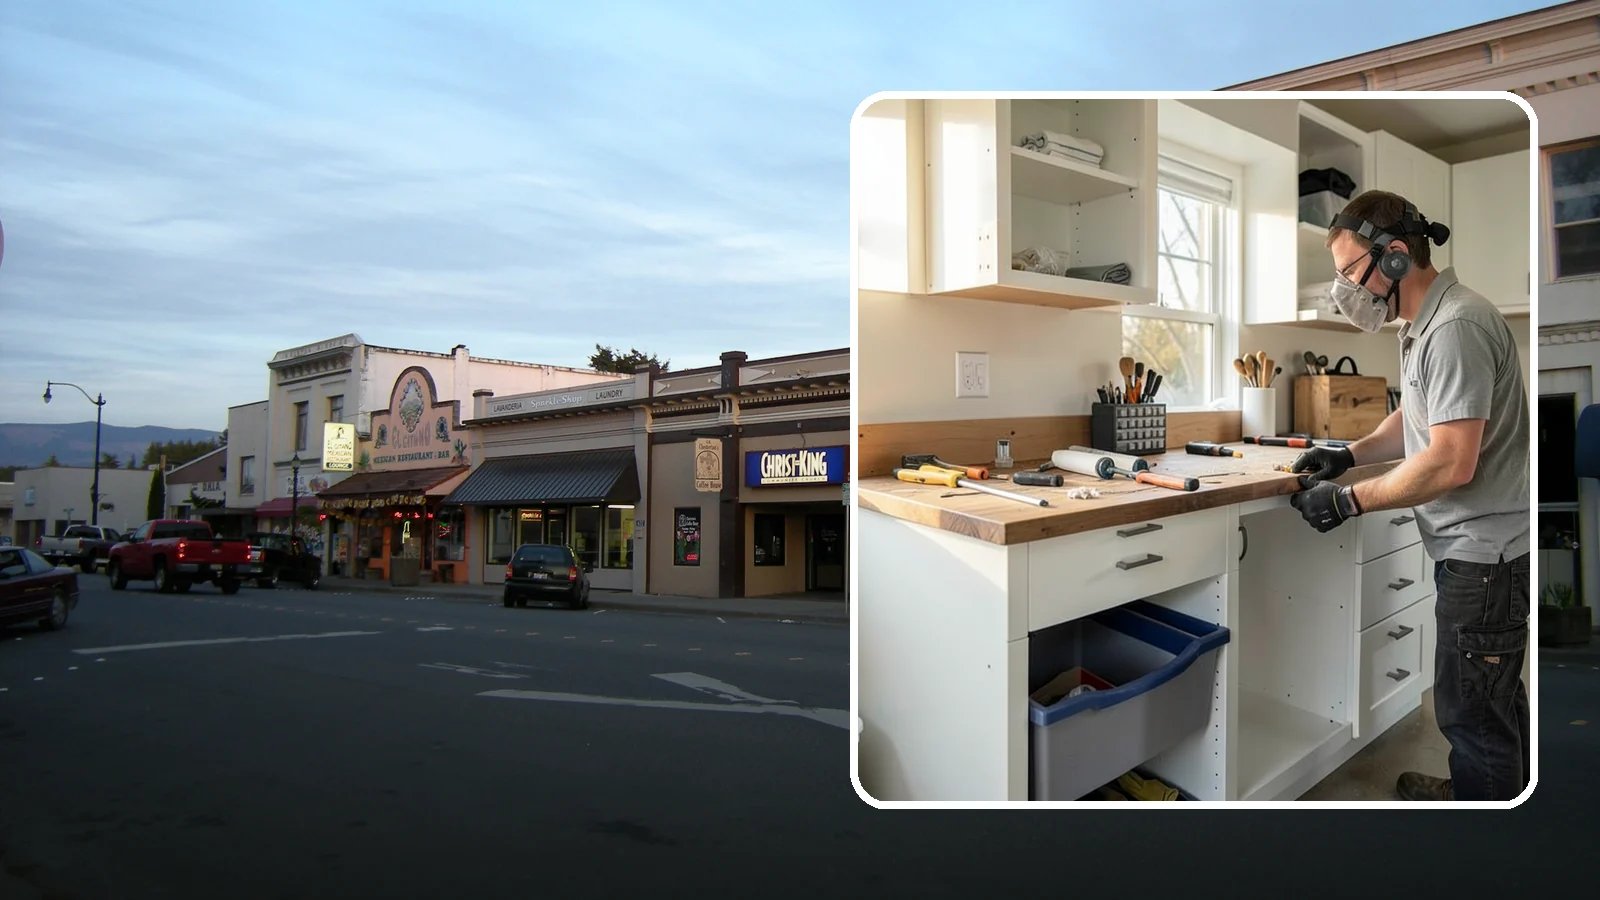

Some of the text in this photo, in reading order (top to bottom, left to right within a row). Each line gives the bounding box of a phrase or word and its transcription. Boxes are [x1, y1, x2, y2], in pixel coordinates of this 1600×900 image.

[561, 394, 582, 404] Shop
[595, 389, 623, 400] LAUNDRY
[493, 402, 522, 412] LAVANDERIA
[374, 450, 450, 464] MEXICAN RESTAURANT BAR
[760, 450, 827, 478] CHRIST KING
